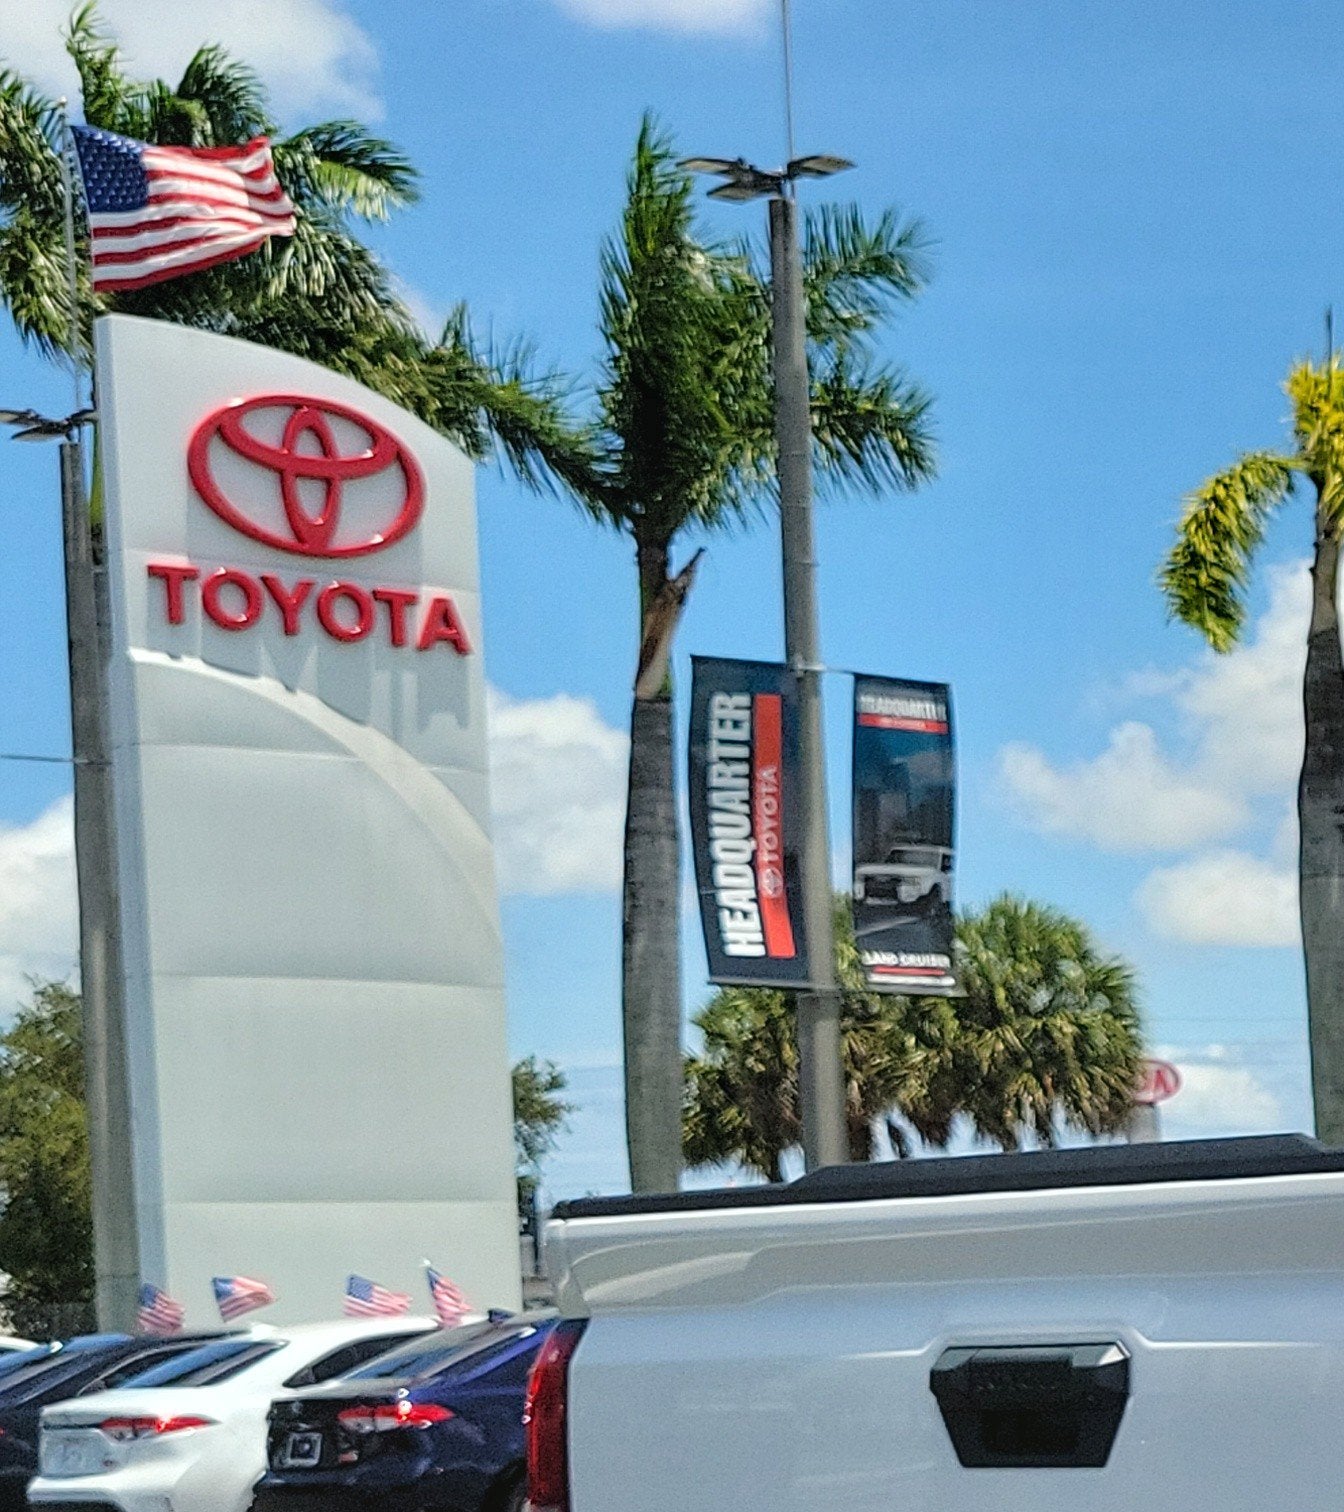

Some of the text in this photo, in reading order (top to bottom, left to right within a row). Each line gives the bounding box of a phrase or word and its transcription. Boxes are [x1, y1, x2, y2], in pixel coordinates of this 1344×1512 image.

[147, 564, 474, 655] TOYOTA
[708, 692, 766, 957] HEADQUARTER
[760, 765, 779, 861] TOYOTA
